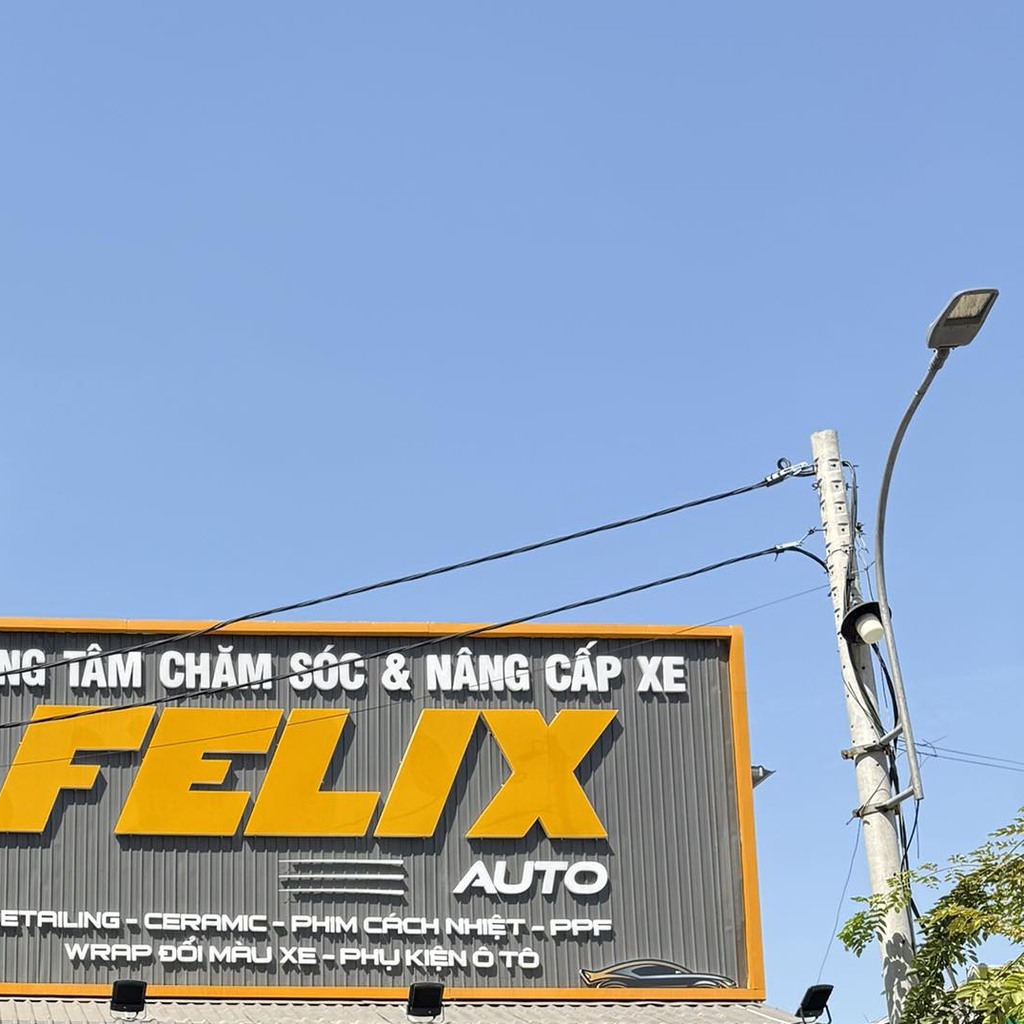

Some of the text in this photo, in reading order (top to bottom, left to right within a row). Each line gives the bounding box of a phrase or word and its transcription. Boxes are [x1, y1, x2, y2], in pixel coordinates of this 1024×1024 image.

[64, 643, 142, 688] TÂM
[159, 644, 272, 690] CHĂM
[289, 644, 365, 691] SÓC
[381, 652, 411, 692] &
[427, 647, 531, 692] NÂNG
[545, 641, 622, 693] CẤP
[637, 656, 686, 692] XE
[453, 860, 608, 895] AUTO
[144, 912, 267, 932] CERAMIC
[292, 915, 358, 934] PHIM
[364, 912, 439, 935] CÁCH
[446, 914, 526, 940] NHIỆT
[550, 919, 613, 936] PPF
[65, 943, 152, 961] WRAP
[158, 936, 203, 963] ĐỔI
[209, 940, 272, 964] MÀU
[280, 947, 316, 964] XE
[340, 948, 400, 971] PHỤ
[406, 945, 467, 971] KIỆN
[472, 946, 494, 968] Ô
[499, 947, 540, 968] TÔ
